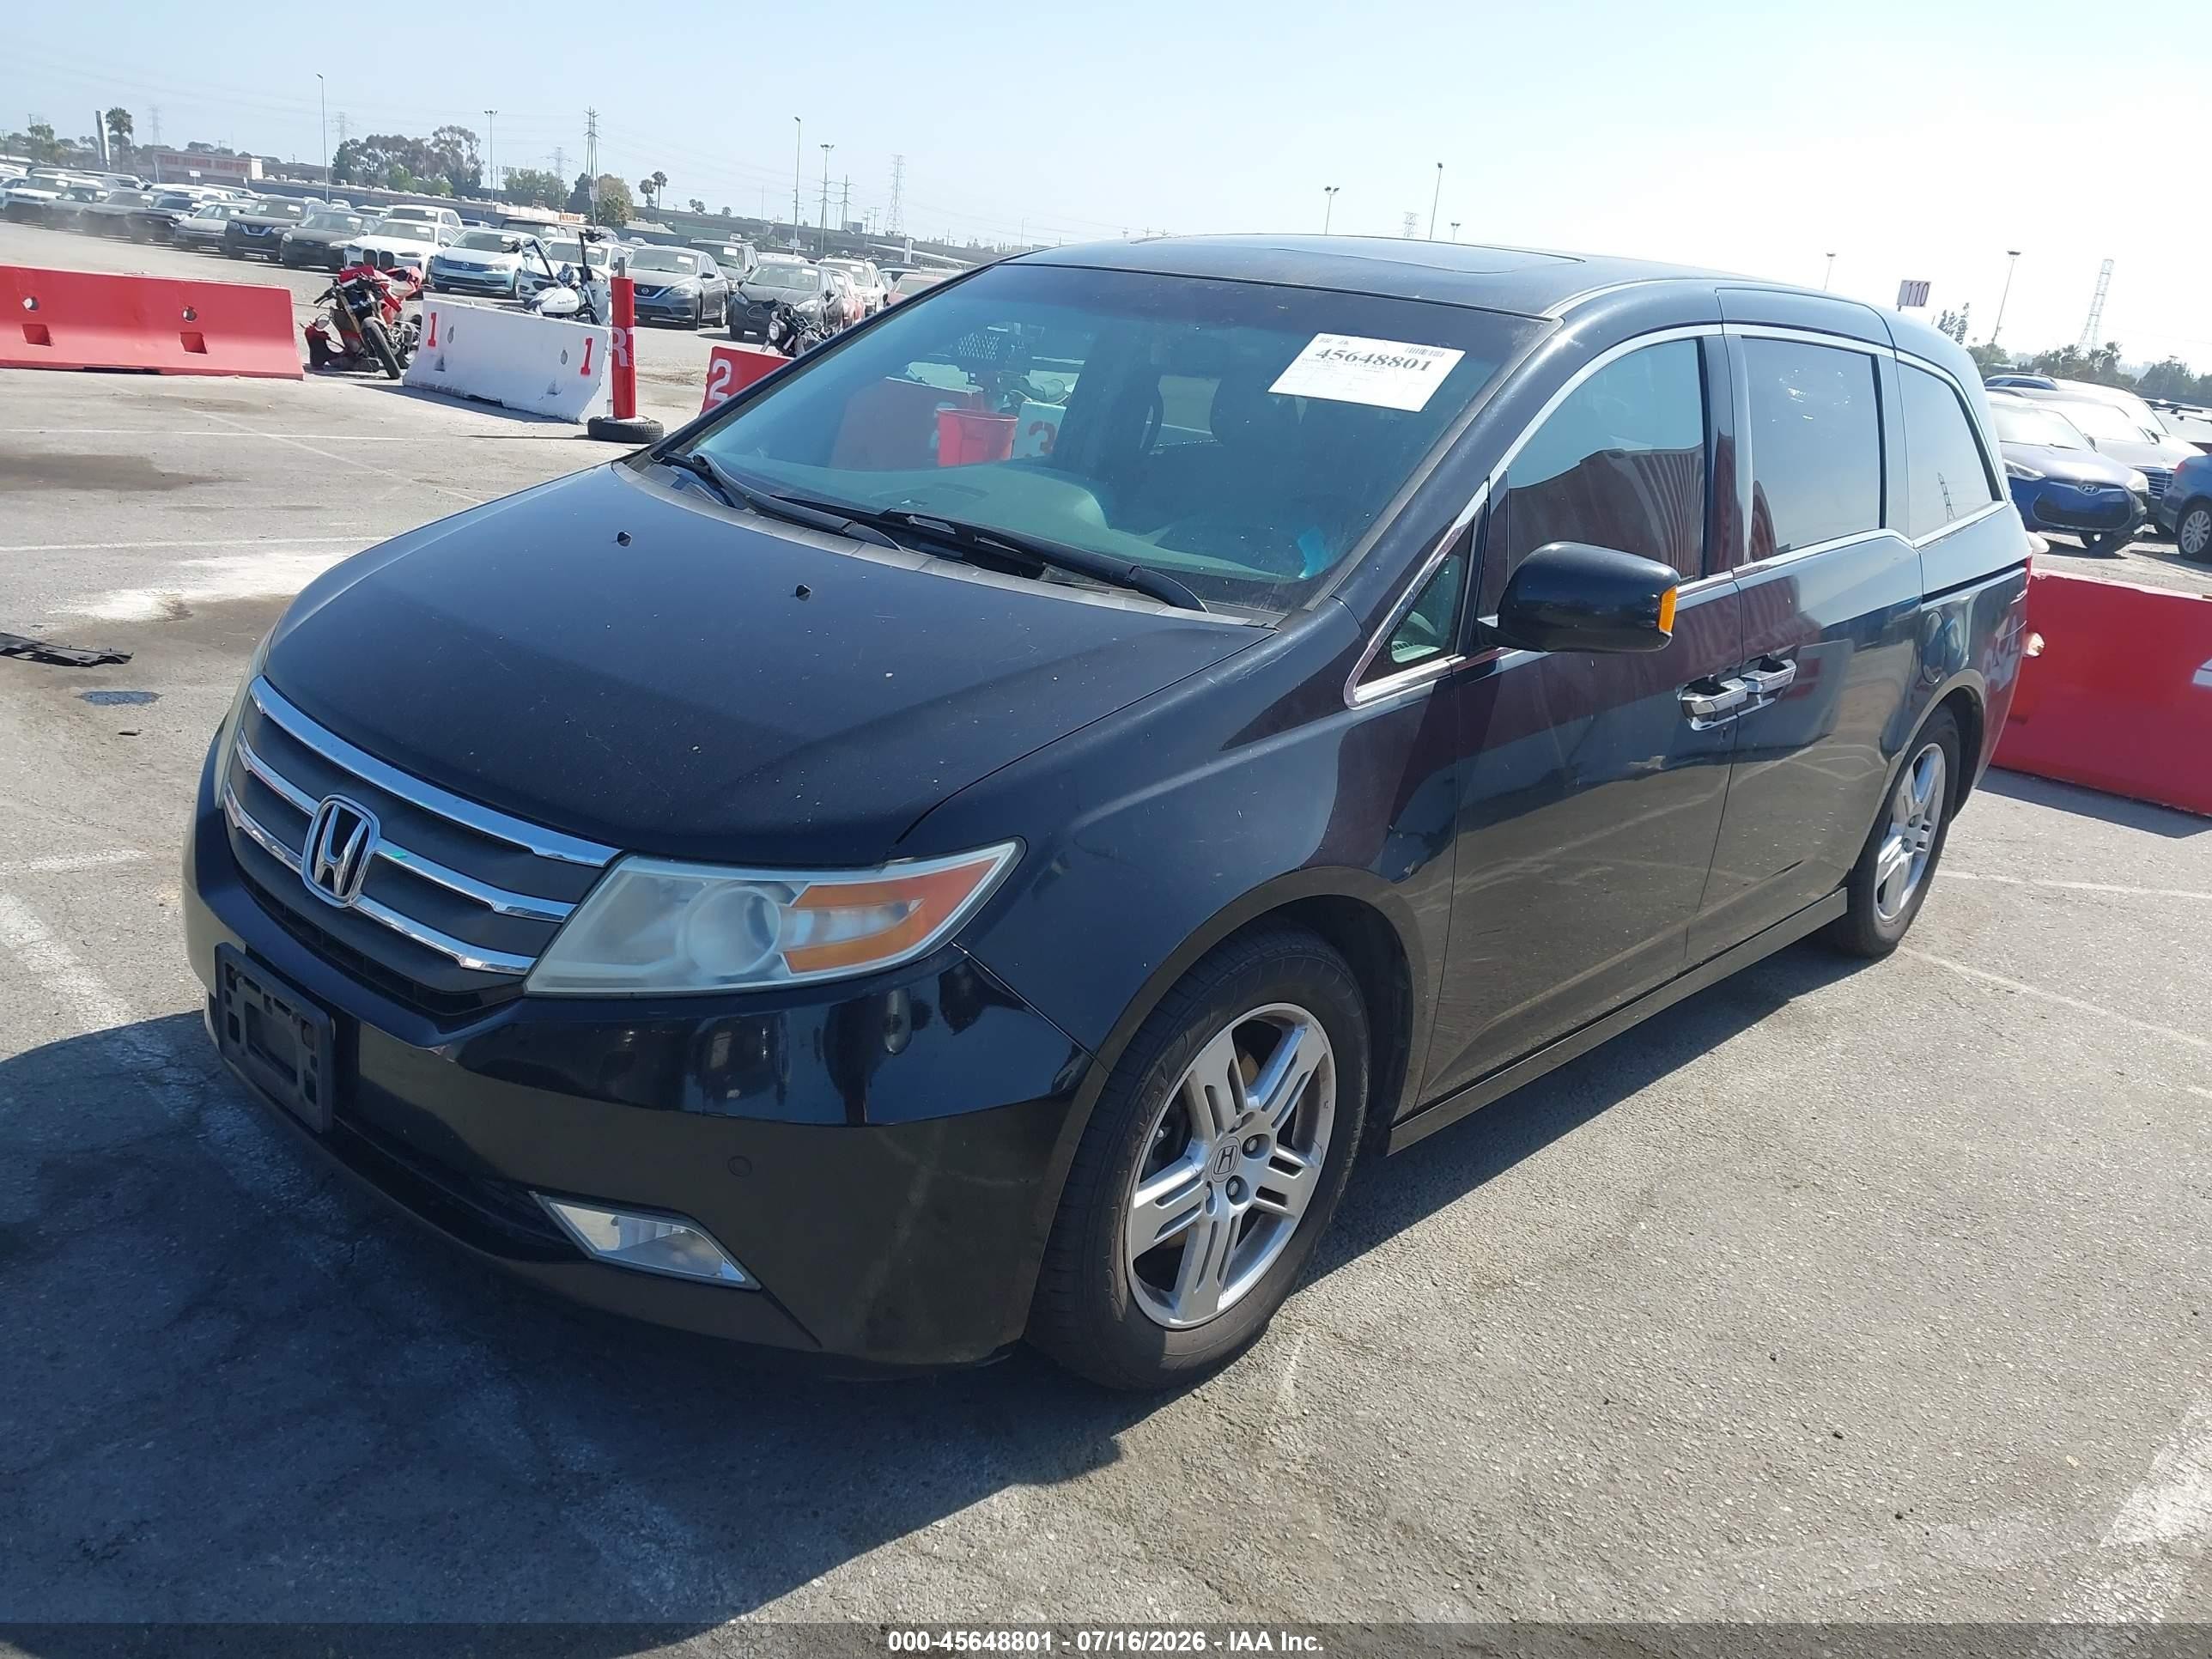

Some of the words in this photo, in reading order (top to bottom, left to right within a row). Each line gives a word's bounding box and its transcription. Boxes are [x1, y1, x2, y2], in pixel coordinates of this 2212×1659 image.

[1906, 282, 1929, 307] 110
[428, 312, 437, 347] 1
[580, 337, 593, 376] 1
[1316, 348, 1432, 372] 45648801
[708, 357, 732, 401] 2
